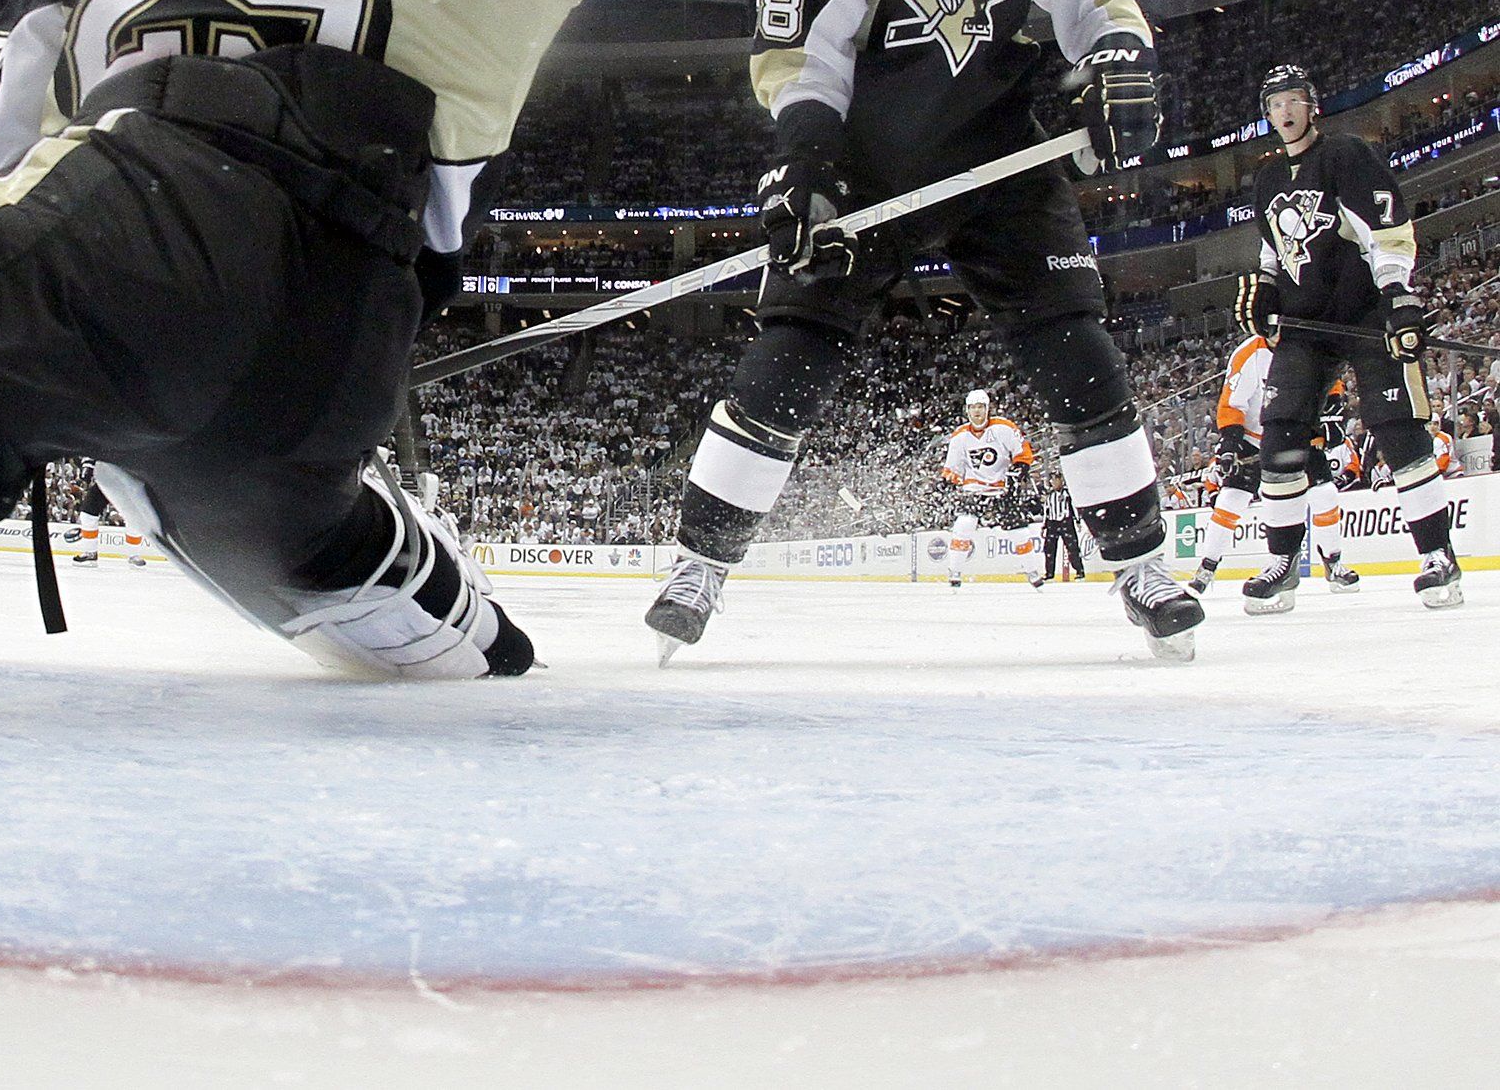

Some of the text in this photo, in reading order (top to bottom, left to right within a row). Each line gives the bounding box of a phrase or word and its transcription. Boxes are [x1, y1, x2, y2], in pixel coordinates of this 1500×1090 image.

[1167, 145, 1189, 159] VAN
[489, 208, 544, 221] HIGHMARK
[1373, 190, 1394, 225] 7
[463, 281, 477, 292] 25
[510, 548, 594, 565] DISCOVER
[816, 543, 854, 567] GEICO
